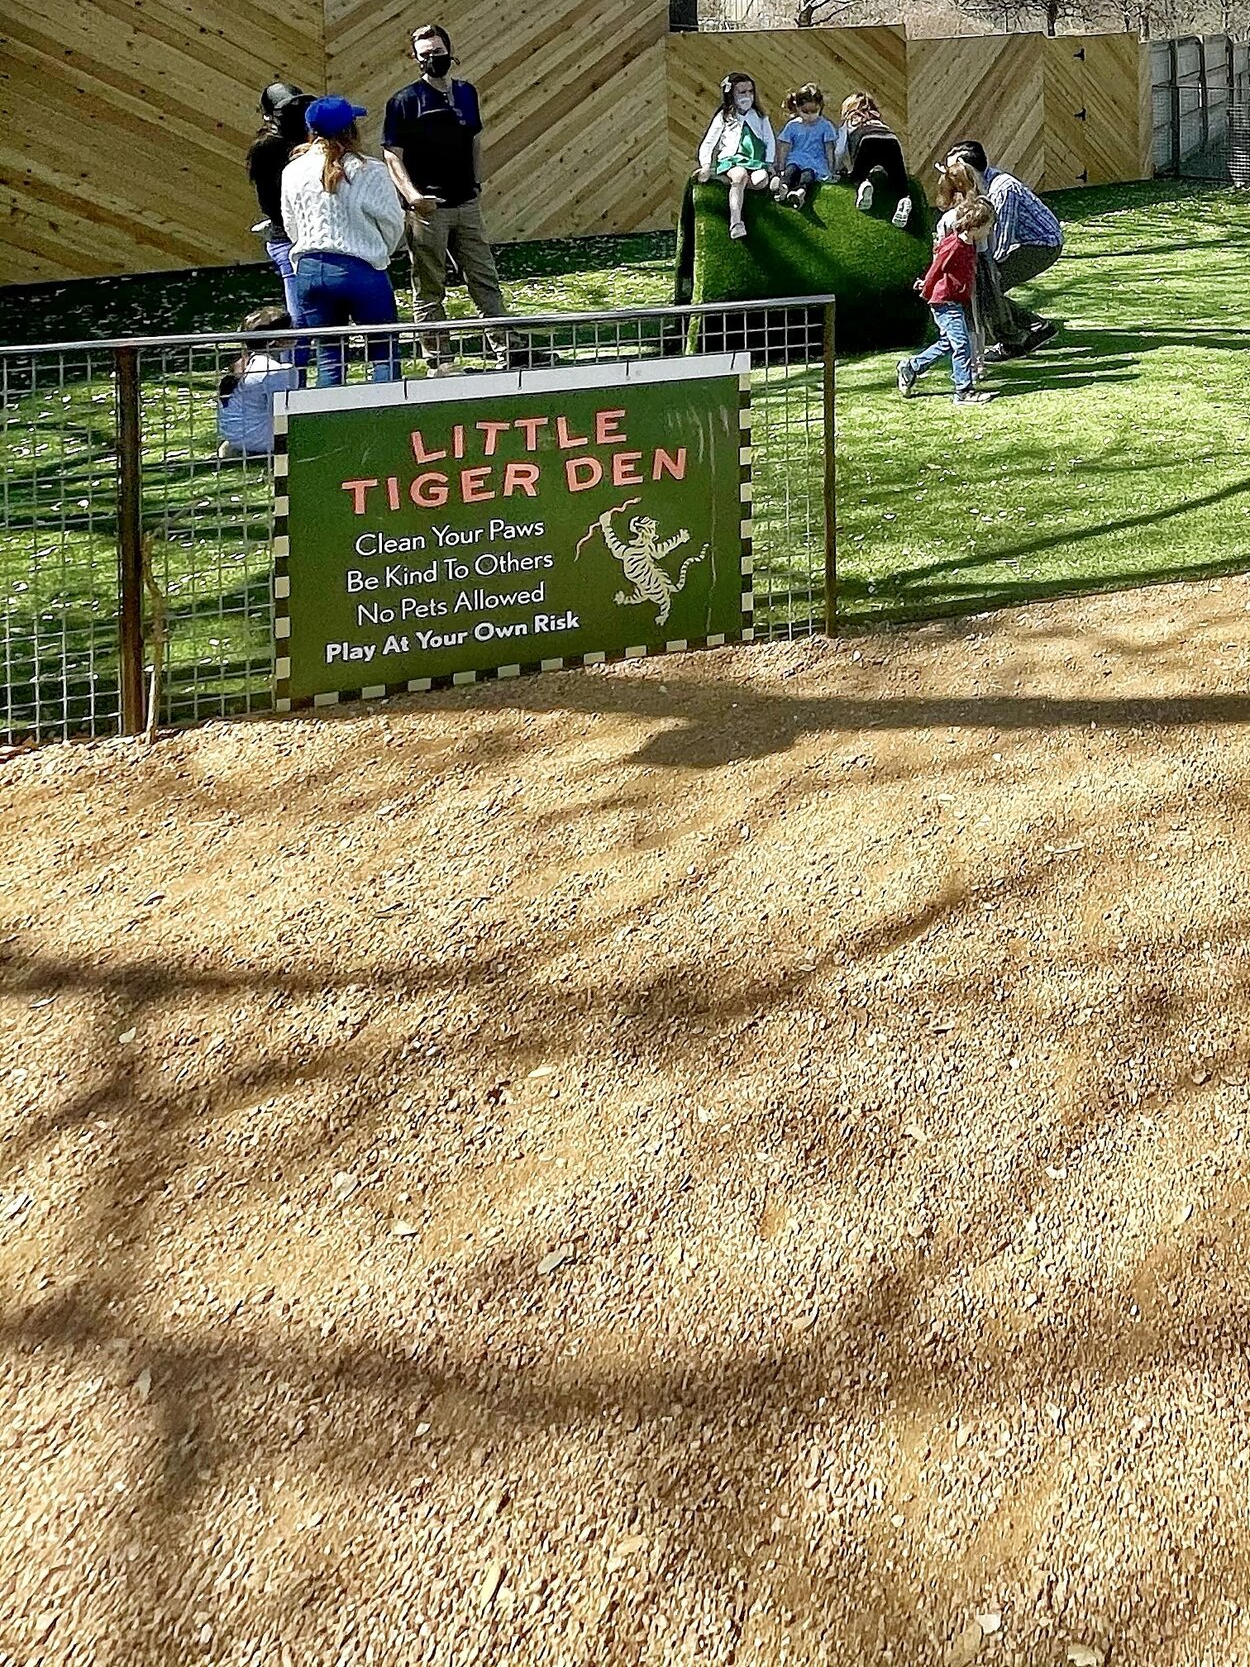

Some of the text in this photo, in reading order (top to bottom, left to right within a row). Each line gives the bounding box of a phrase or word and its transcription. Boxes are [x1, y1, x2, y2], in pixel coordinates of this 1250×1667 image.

[410, 408, 628, 465] LITTLE
[341, 447, 687, 515] TIGER DEN
[355, 518, 545, 557] Clean Your Paws
[347, 551, 554, 593] Be Kind To Others
[357, 580, 545, 626] No Pets Allowed
[325, 610, 580, 663] Play At Your Own Risk
